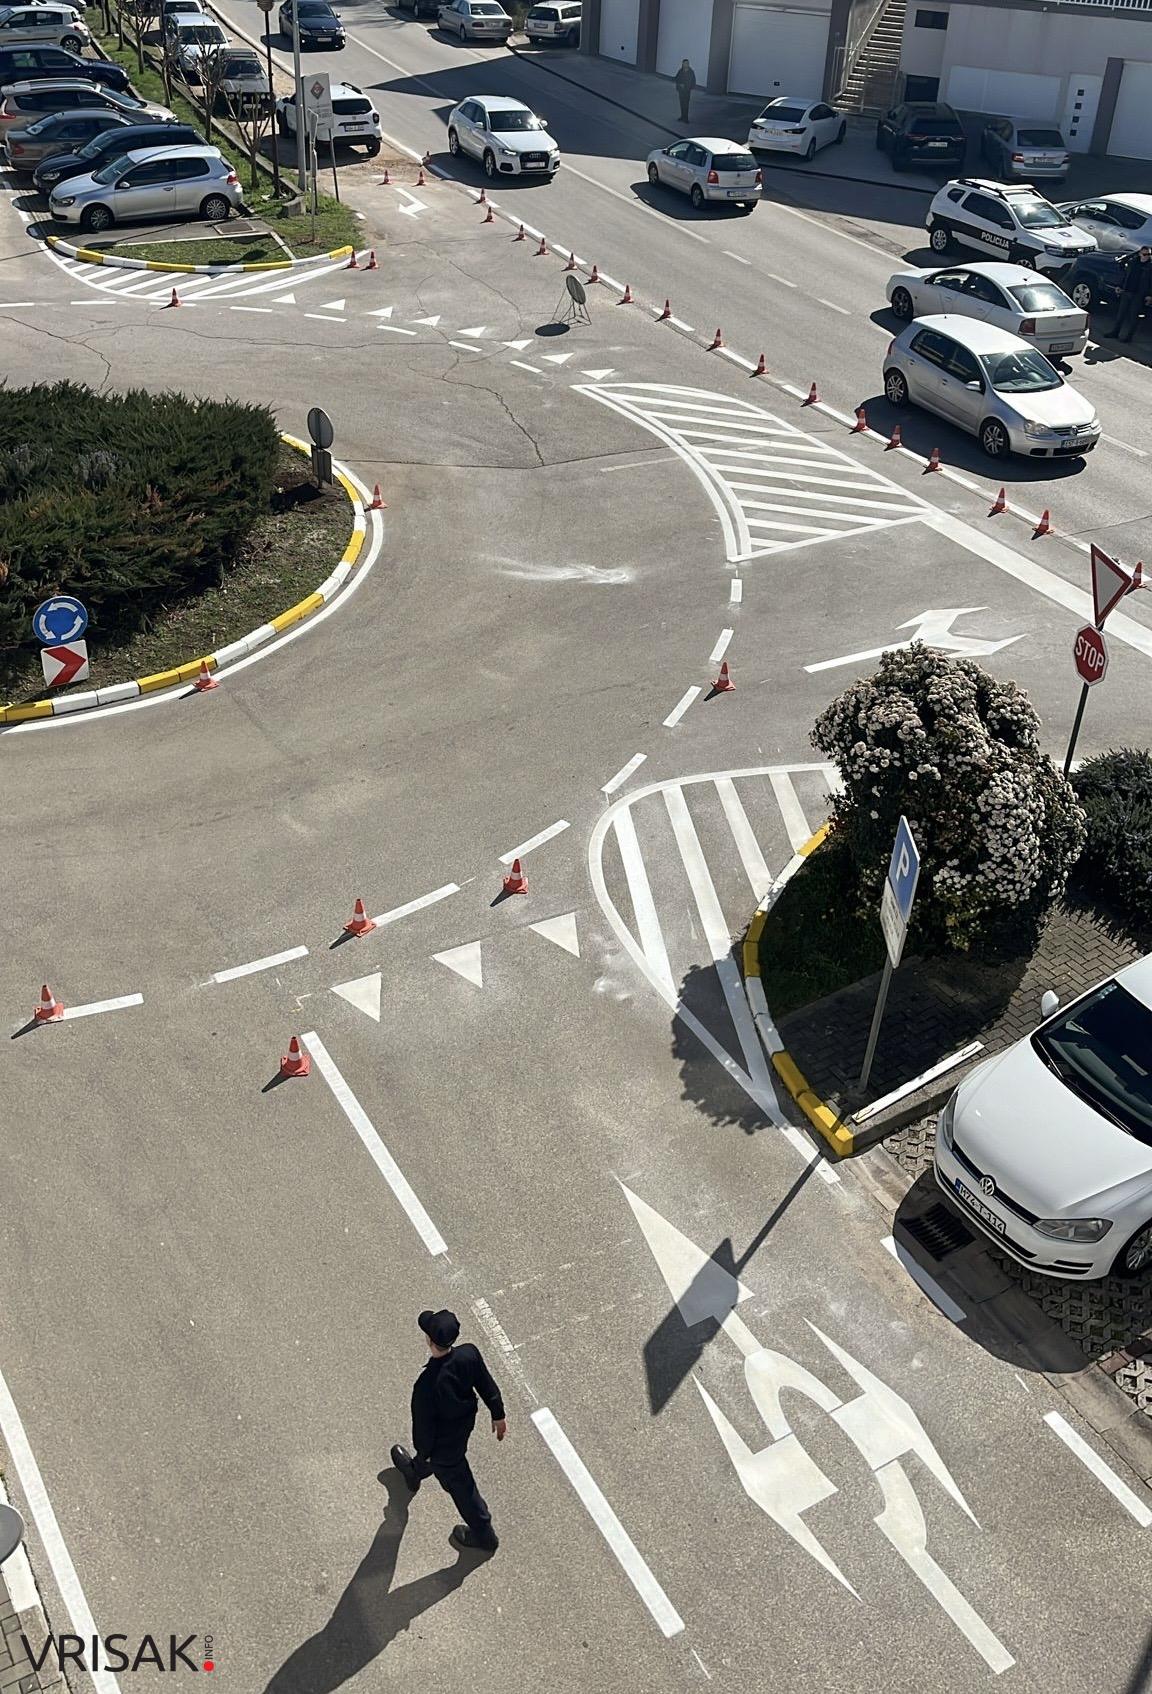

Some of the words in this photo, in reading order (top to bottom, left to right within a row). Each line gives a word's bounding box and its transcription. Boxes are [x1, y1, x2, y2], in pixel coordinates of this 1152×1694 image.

[981, 231, 1011, 249] POLICIJA
[1075, 636, 1105, 672] STOP
[895, 841, 910, 882] P
